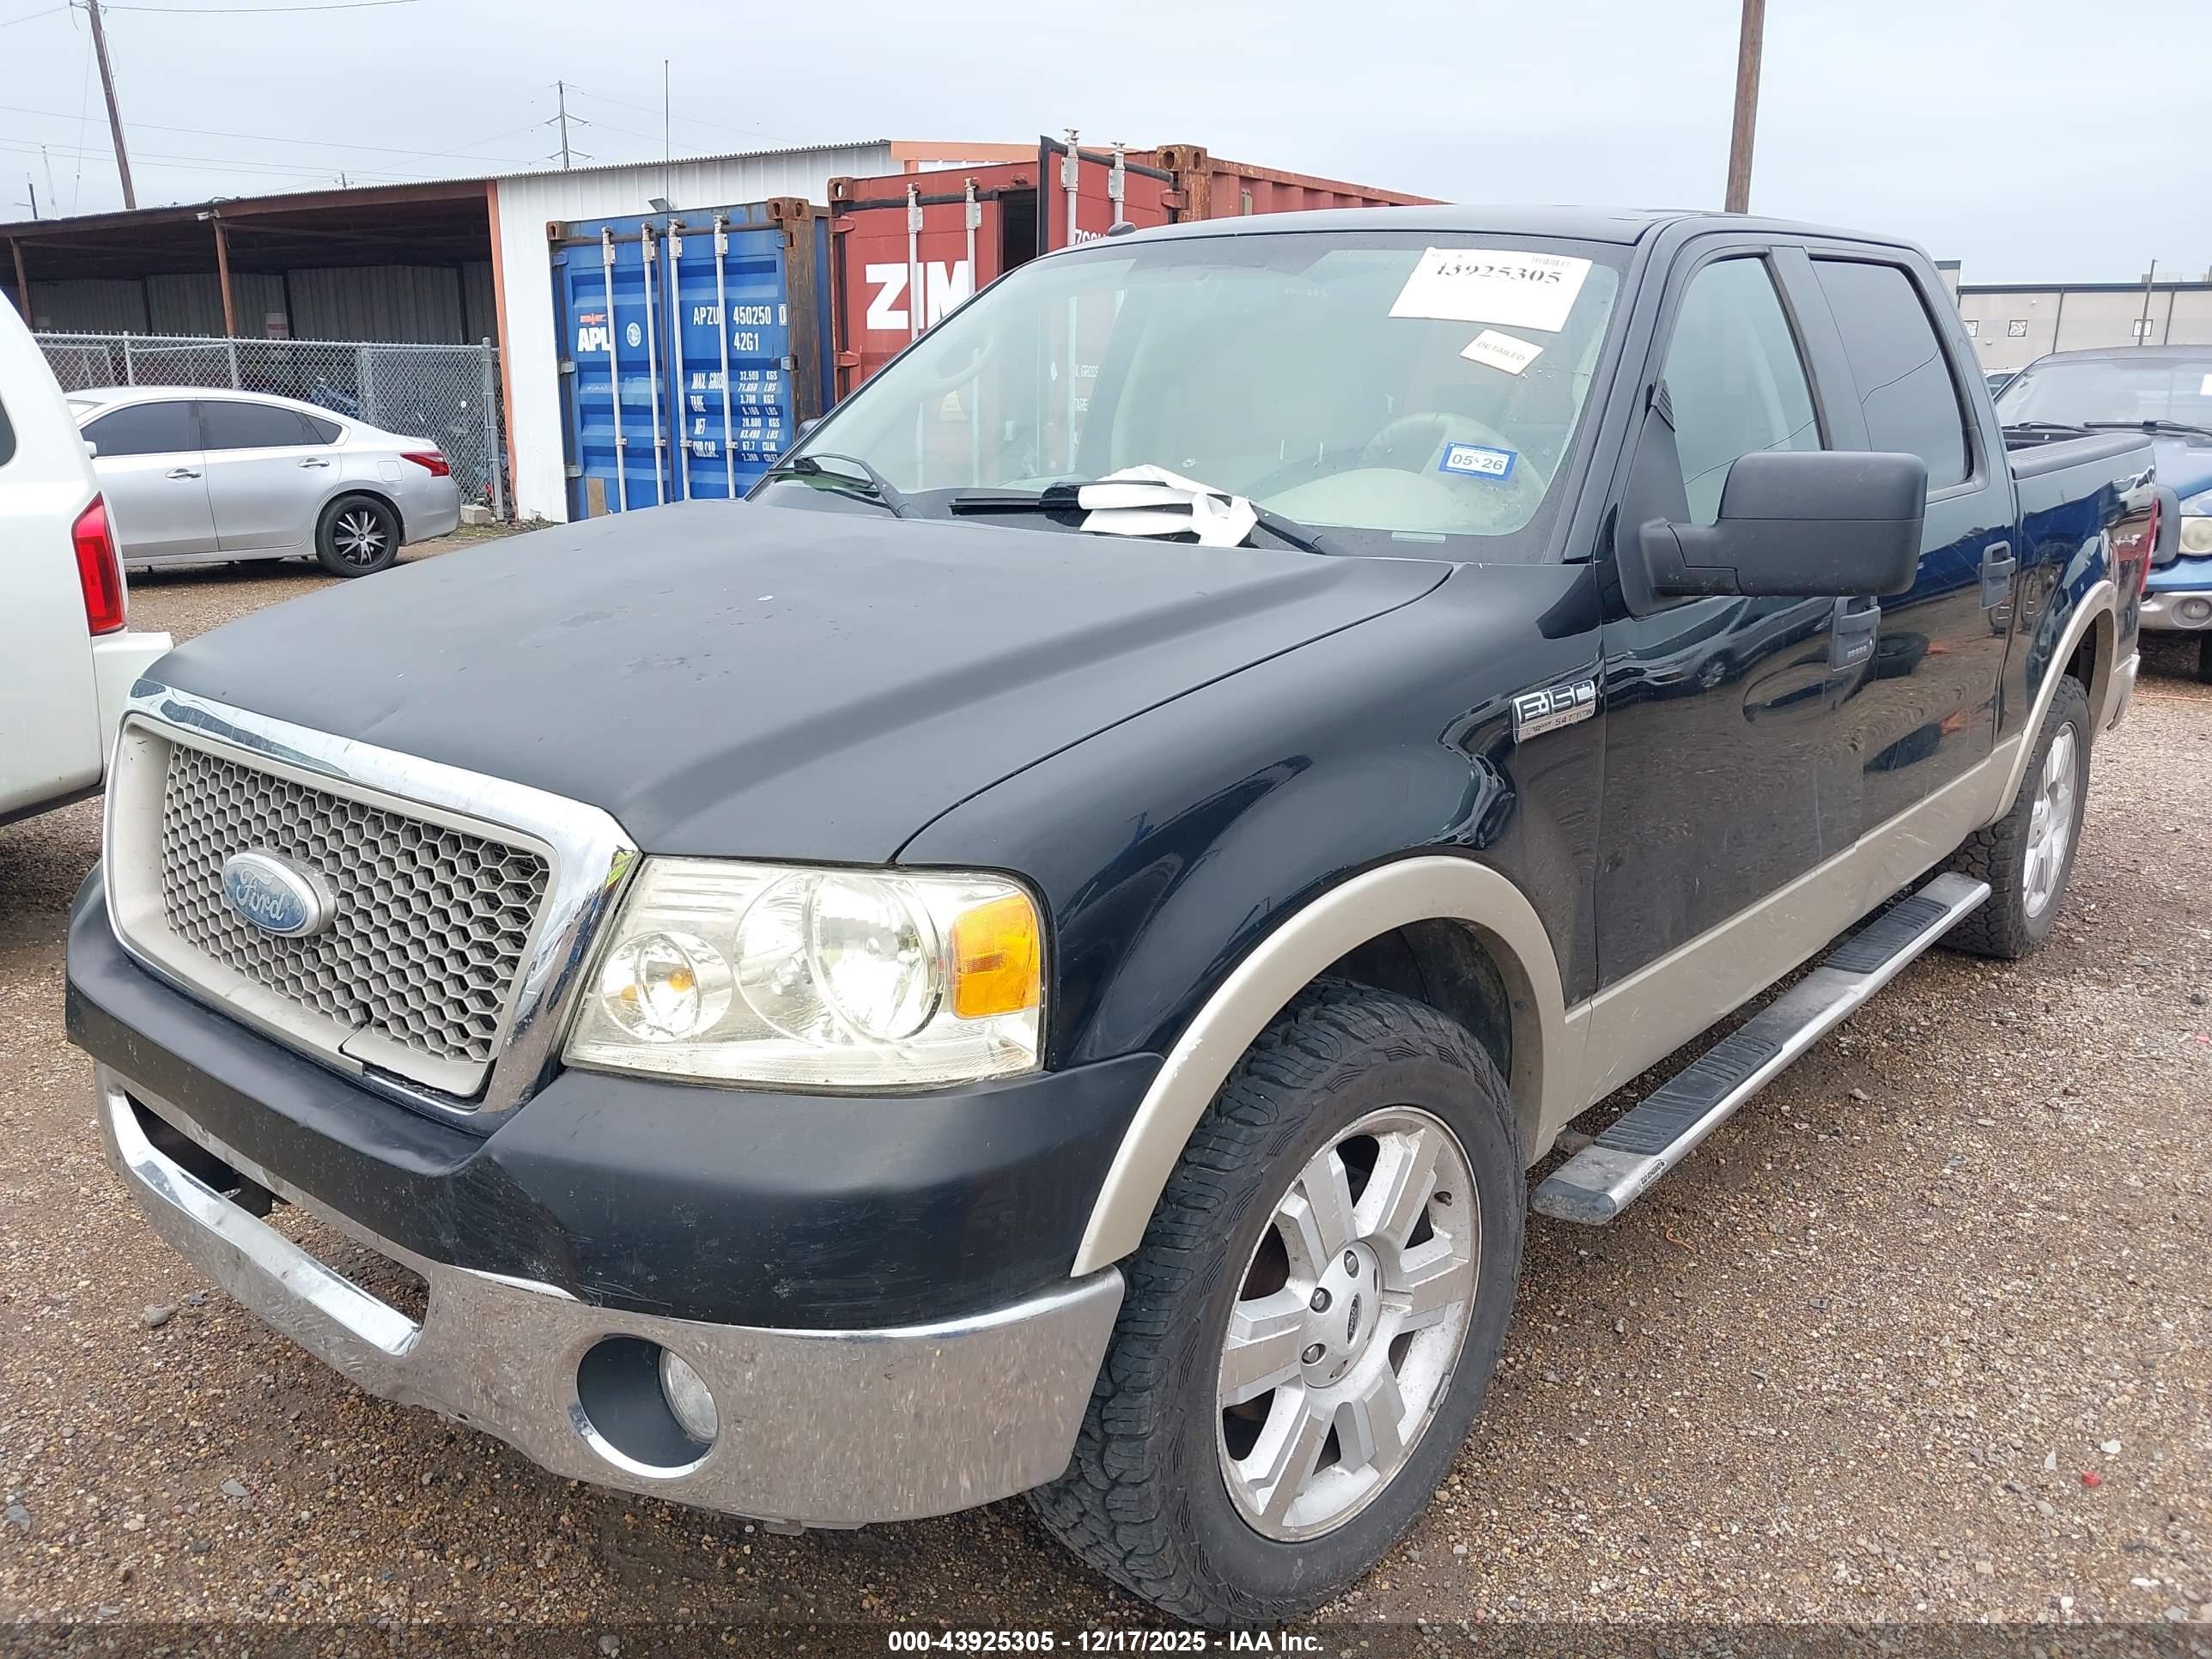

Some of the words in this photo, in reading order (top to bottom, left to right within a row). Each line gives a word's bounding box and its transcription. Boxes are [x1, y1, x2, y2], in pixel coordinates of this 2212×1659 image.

[865, 260, 969, 330] ZIM
[693, 307, 719, 325] APZU
[732, 306, 772, 325] 450250
[779, 304, 787, 325] 0
[577, 327, 612, 352] APL
[733, 332, 759, 350] 42G1
[708, 372, 724, 390] GROS
[766, 371, 777, 380] KGS
[763, 383, 776, 392] LBS
[763, 395, 775, 404] KGS
[769, 418, 780, 428] KGS
[766, 429, 779, 439] LBS
[235, 868, 285, 921] Ford
